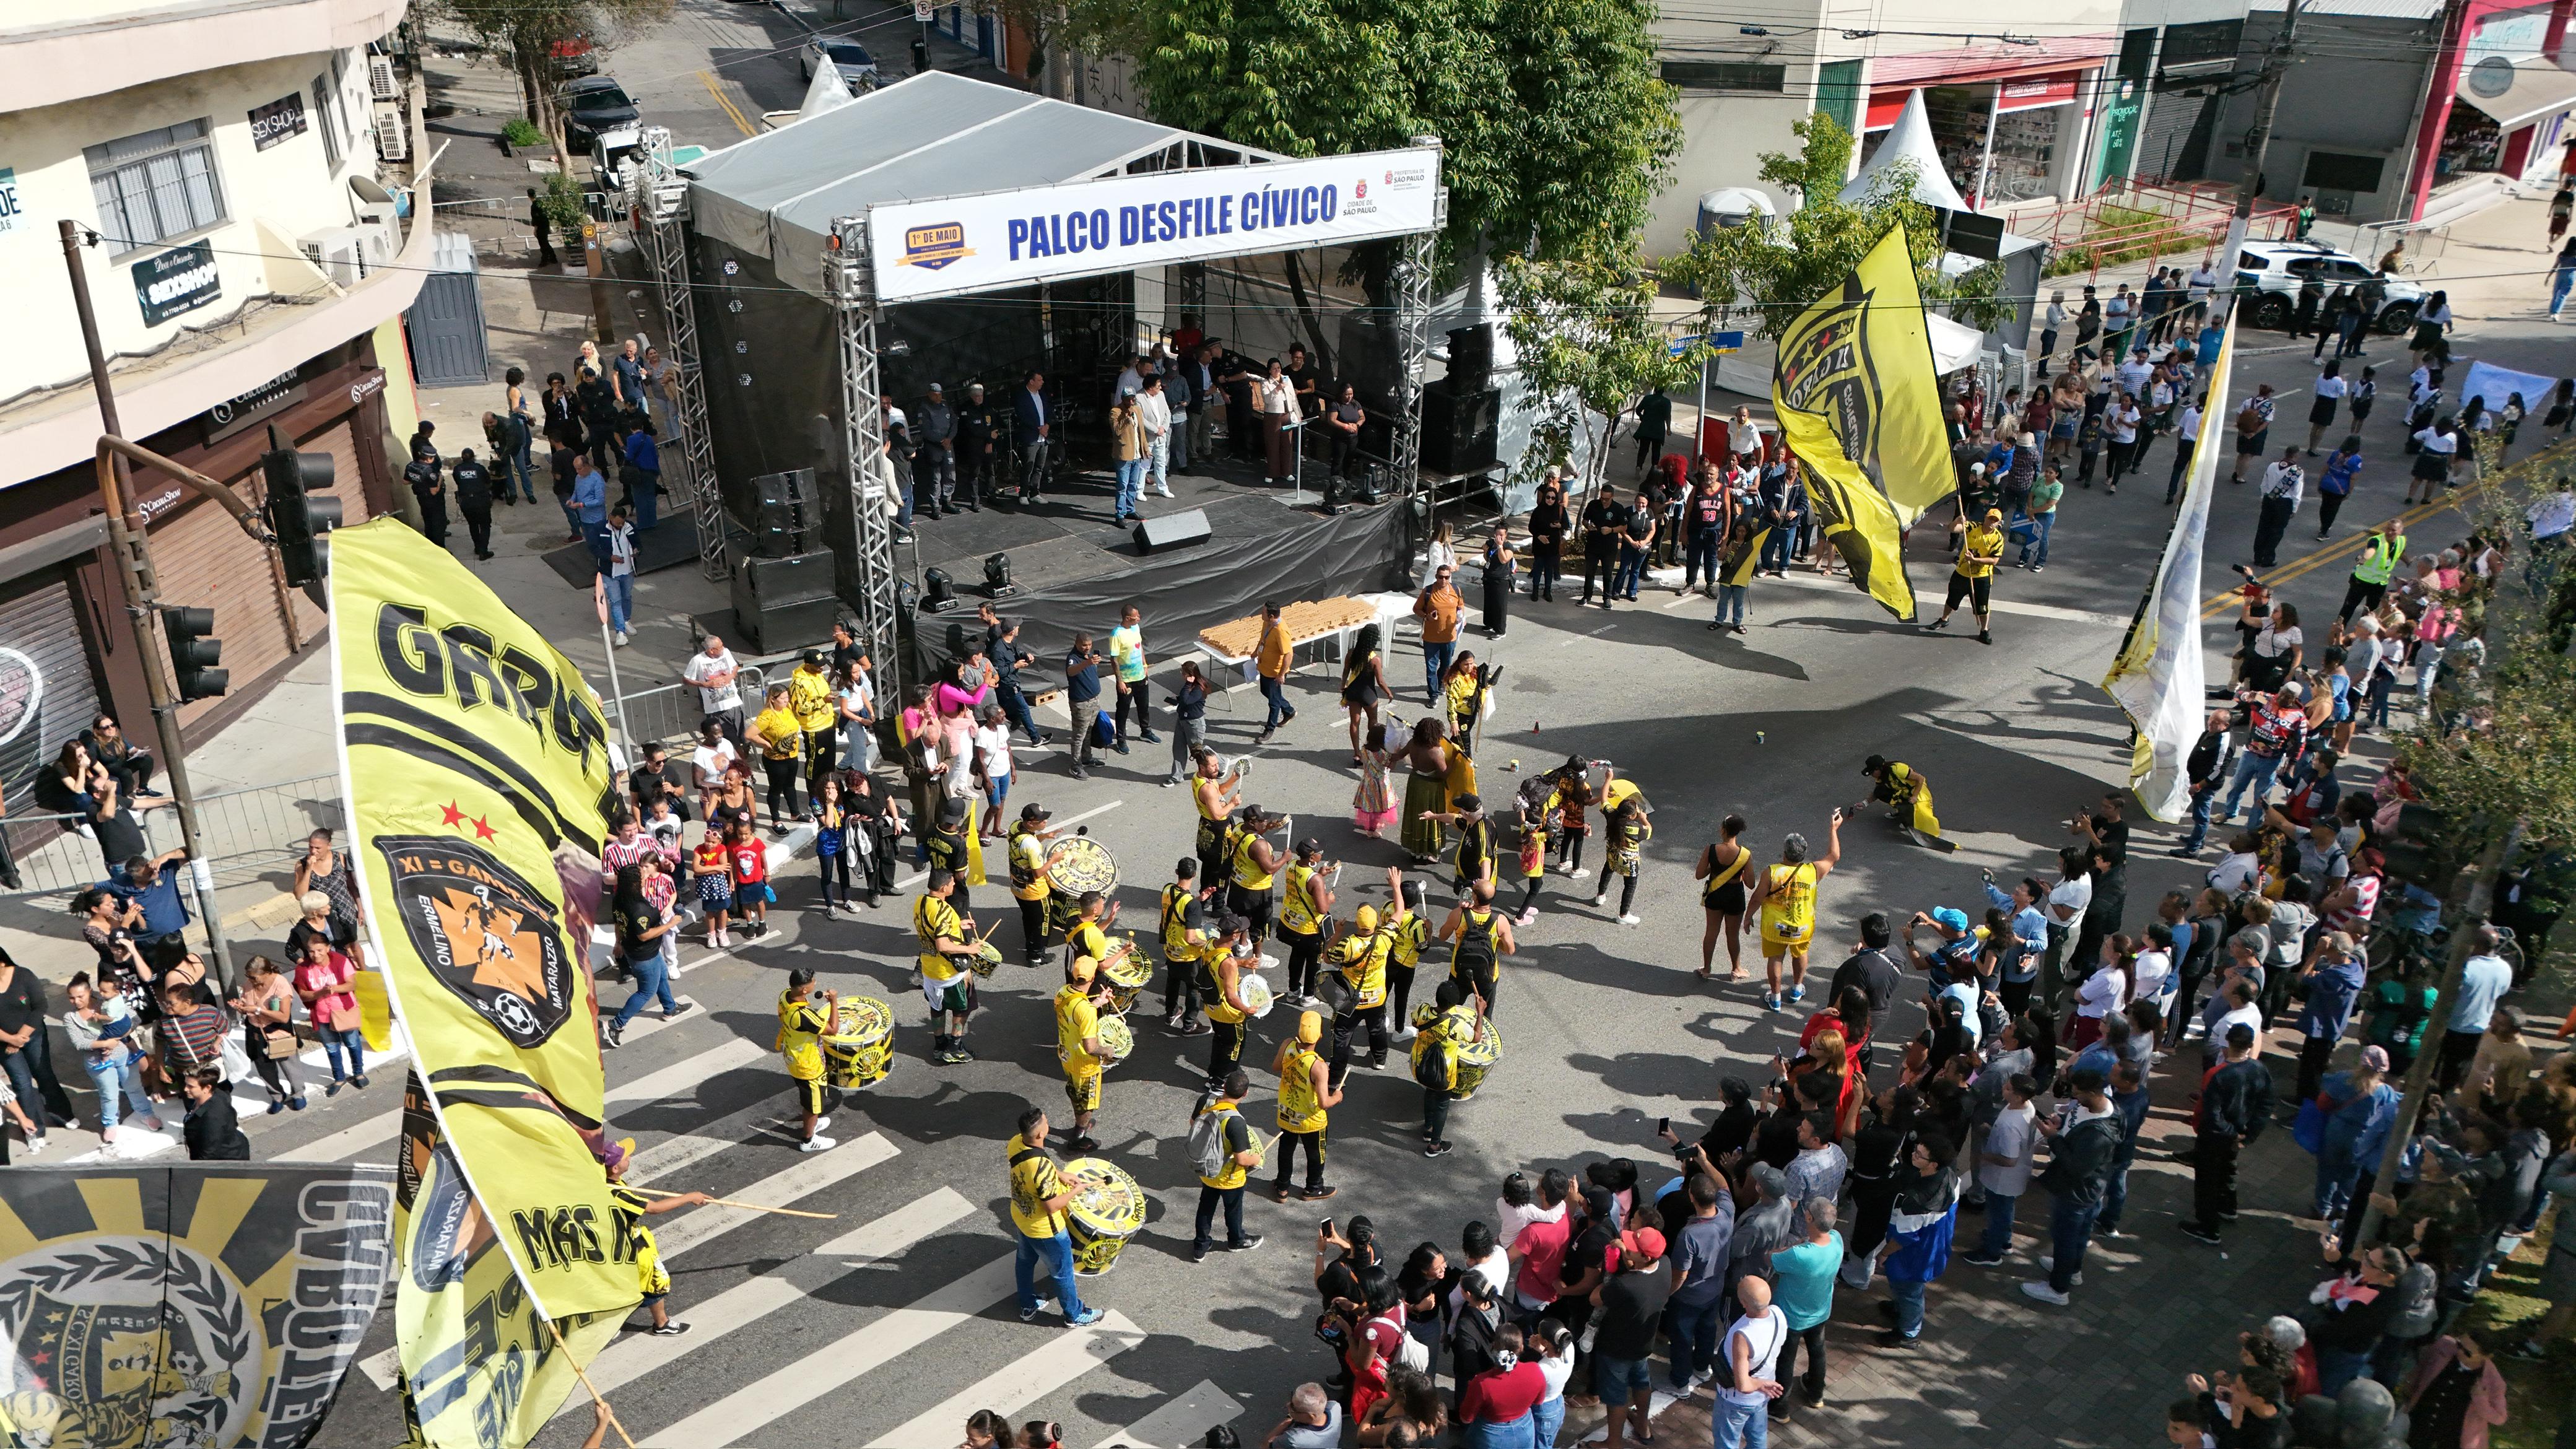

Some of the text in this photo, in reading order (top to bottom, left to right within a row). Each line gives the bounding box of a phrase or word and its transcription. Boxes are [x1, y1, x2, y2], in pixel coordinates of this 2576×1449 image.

[2005, 82, 2048, 95] americanas
[251, 118, 272, 140] SEX
[271, 108, 295, 132] SHOP
[1343, 206, 1377, 215] SÃO PAULO
[1008, 183, 1338, 261] PALCO DESFILE CÍVICO
[923, 232, 933, 243] DE
[936, 228, 957, 242] MAIO
[1699, 500, 1722, 510] BULLS
[1703, 510, 1717, 521] 23
[2258, 708, 2291, 729] REPOL
[399, 856, 425, 873] XI
[1068, 849, 1113, 891] PEGADA DO TIGRE
[418, 894, 451, 967] ERMELINO
[544, 936, 563, 1010] MATARAZZO
[510, 1204, 606, 1273] MAS
